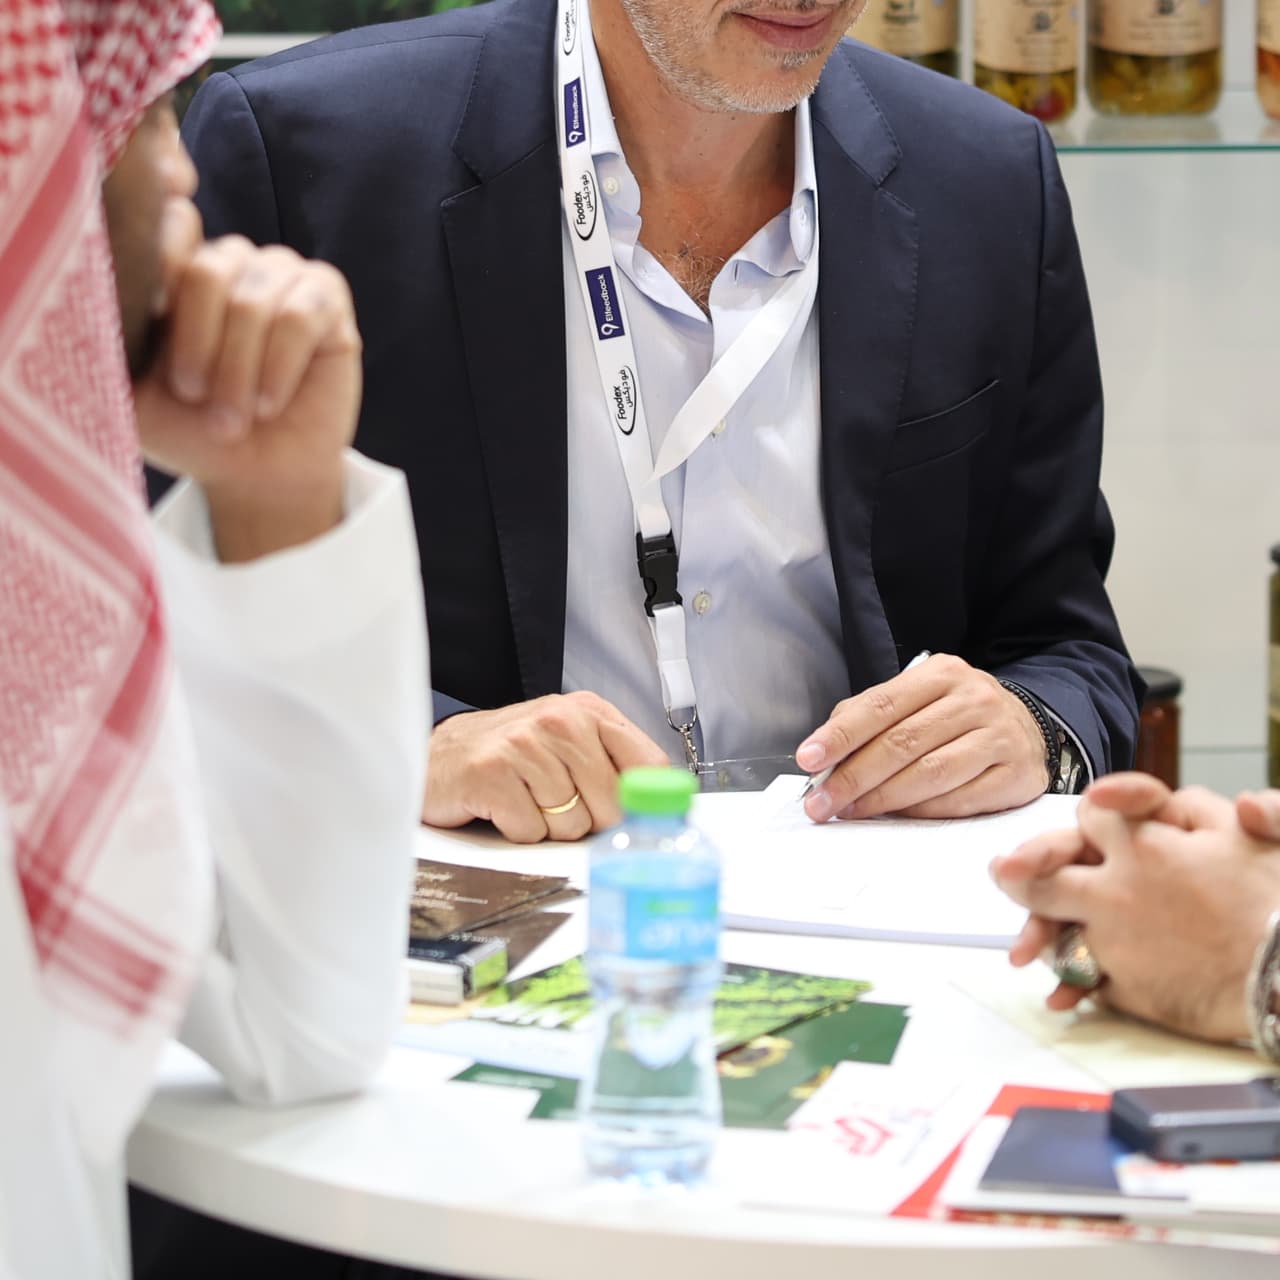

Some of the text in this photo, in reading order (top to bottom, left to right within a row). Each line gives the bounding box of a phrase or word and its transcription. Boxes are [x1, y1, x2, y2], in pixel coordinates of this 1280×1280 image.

[574, 191, 587, 225] Foodex
[597, 273, 614, 322] Elfeedback
[613, 385, 627, 420] Foodex
